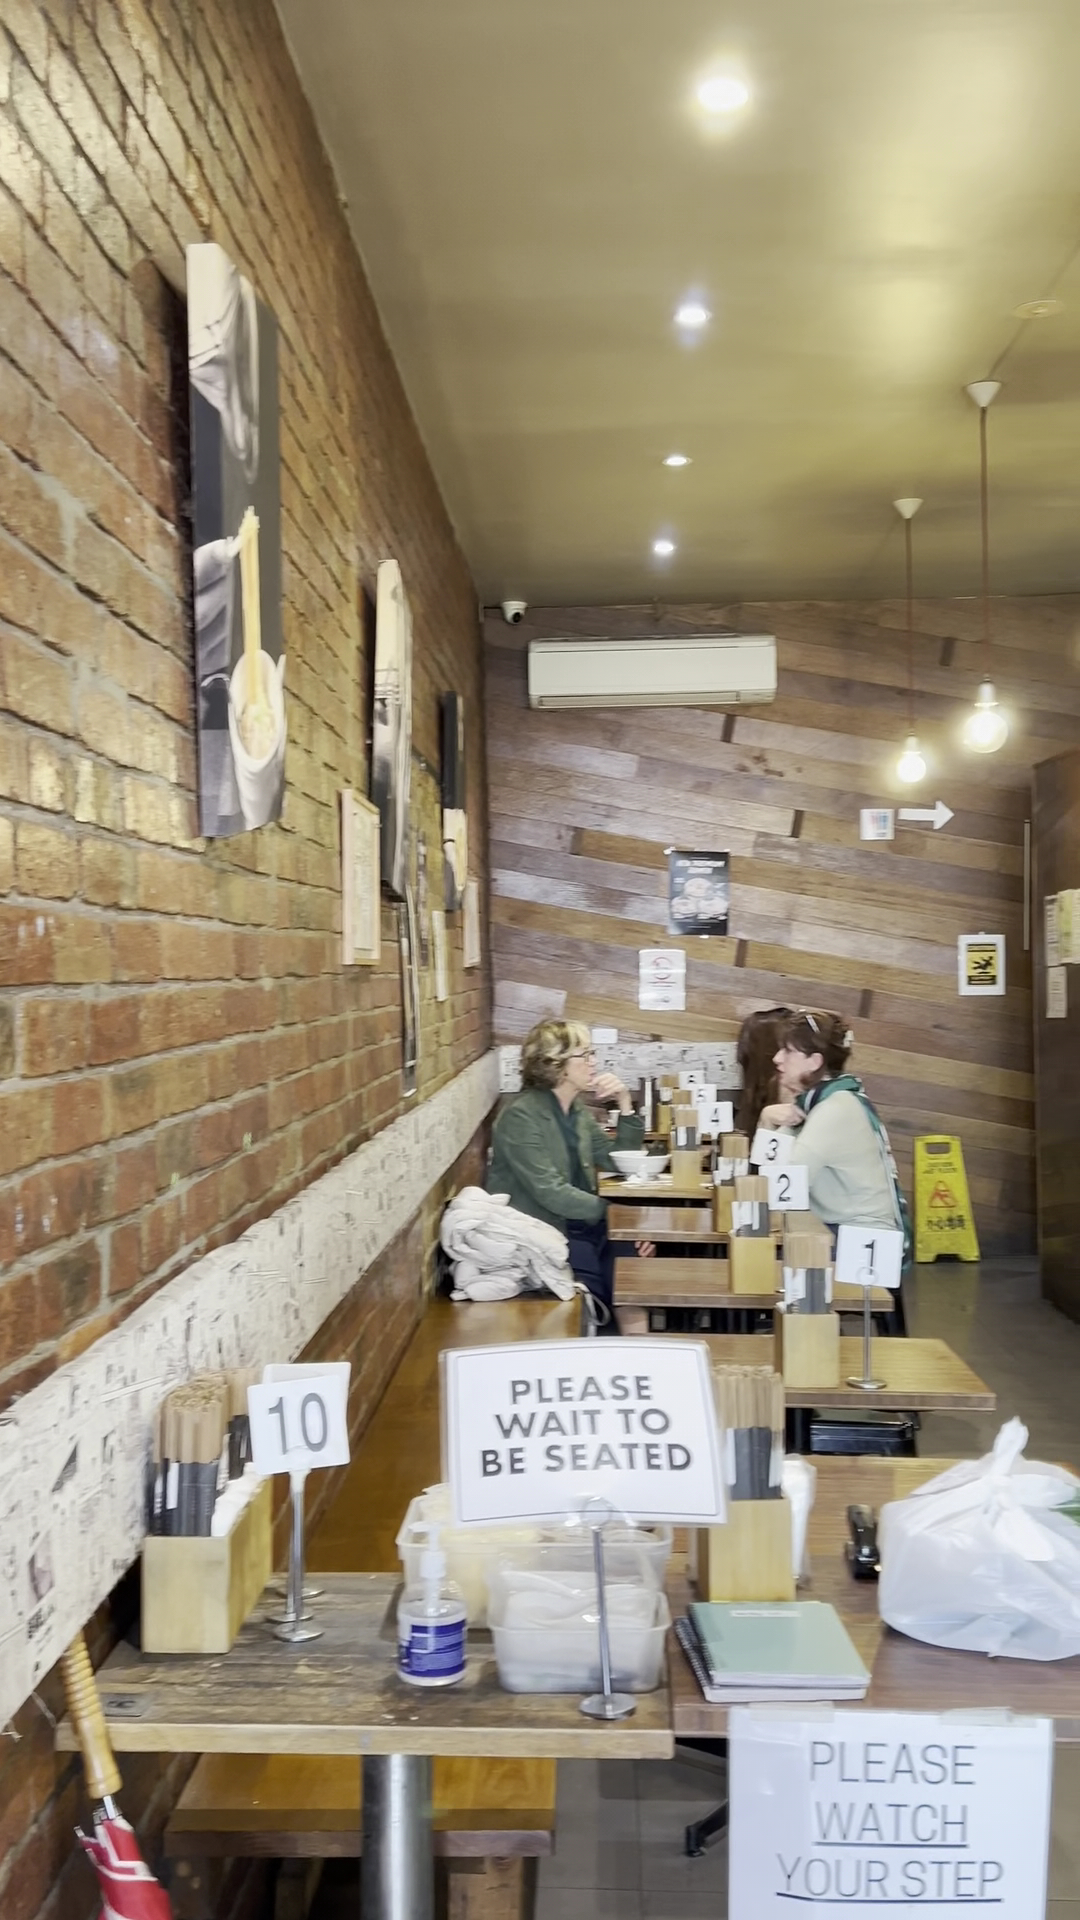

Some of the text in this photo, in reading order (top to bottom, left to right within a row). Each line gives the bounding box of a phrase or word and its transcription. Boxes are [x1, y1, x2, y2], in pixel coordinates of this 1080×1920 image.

[710, 1107, 720, 1126] 4
[765, 1138, 779, 1161] 3
[777, 1173, 791, 1202] 2
[863, 1239, 876, 1275] 1
[510, 1375, 653, 1404] PLEASE
[267, 1392, 328, 1455] 10
[495, 1408, 670, 1439] WAIT TO
[481, 1443, 691, 1477] BE SEATED
[809, 1741, 977, 1785] PLEASE
[815, 1801, 968, 1843] WATCH
[776, 1853, 1004, 1898] YOUR STEP
